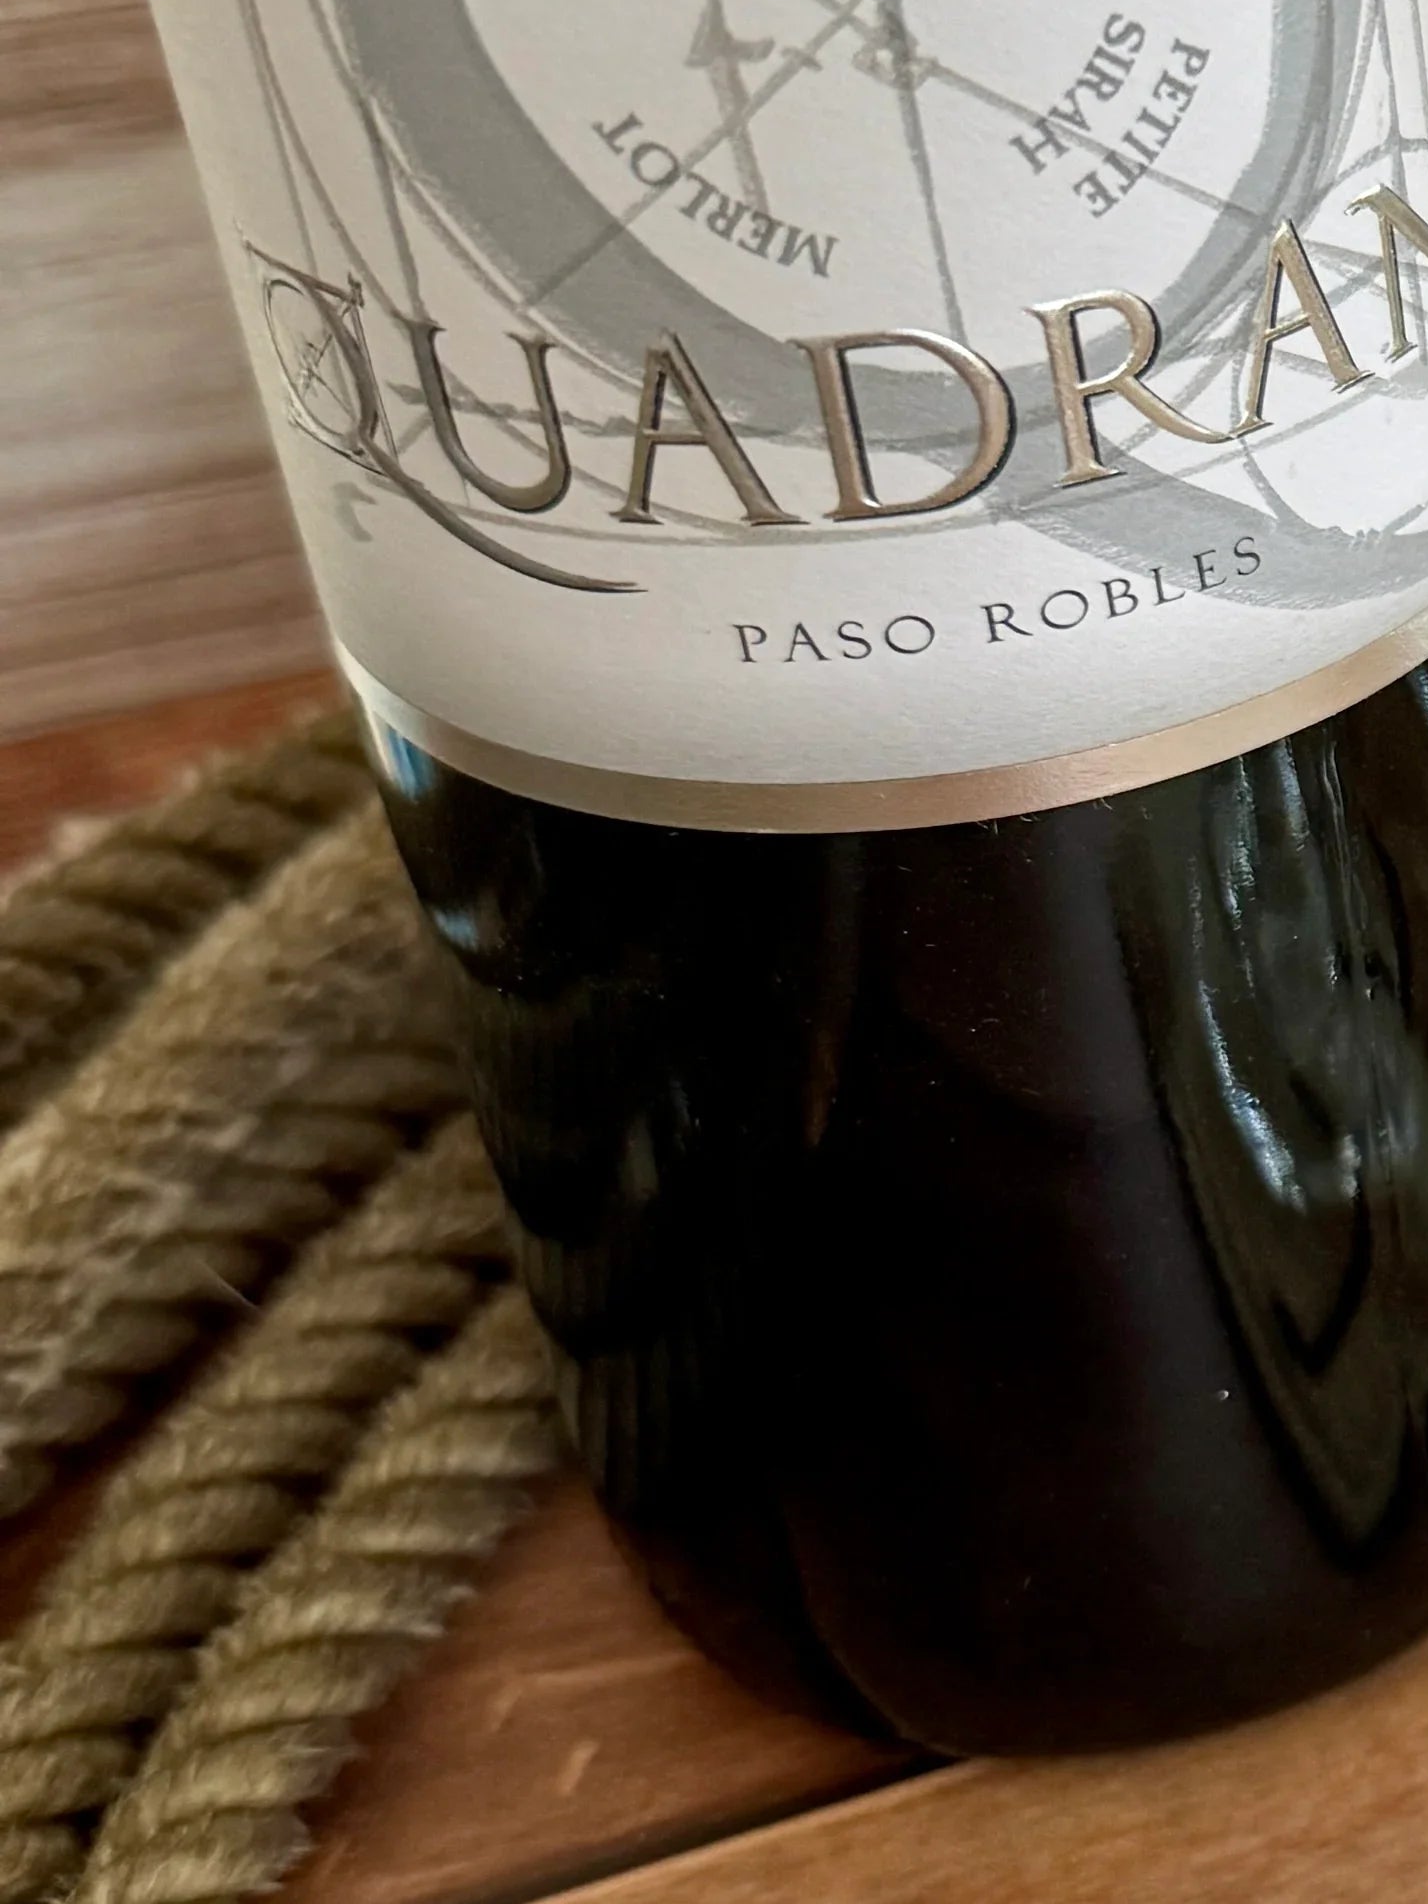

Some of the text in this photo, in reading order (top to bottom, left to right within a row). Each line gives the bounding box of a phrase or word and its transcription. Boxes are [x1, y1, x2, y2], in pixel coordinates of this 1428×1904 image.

[1008, 11, 1147, 175] SIRAH
[1072, 36, 1211, 218] PETITE
[591, 112, 840, 280] MERLOT
[733, 534, 1266, 665] PASO ROBLES
